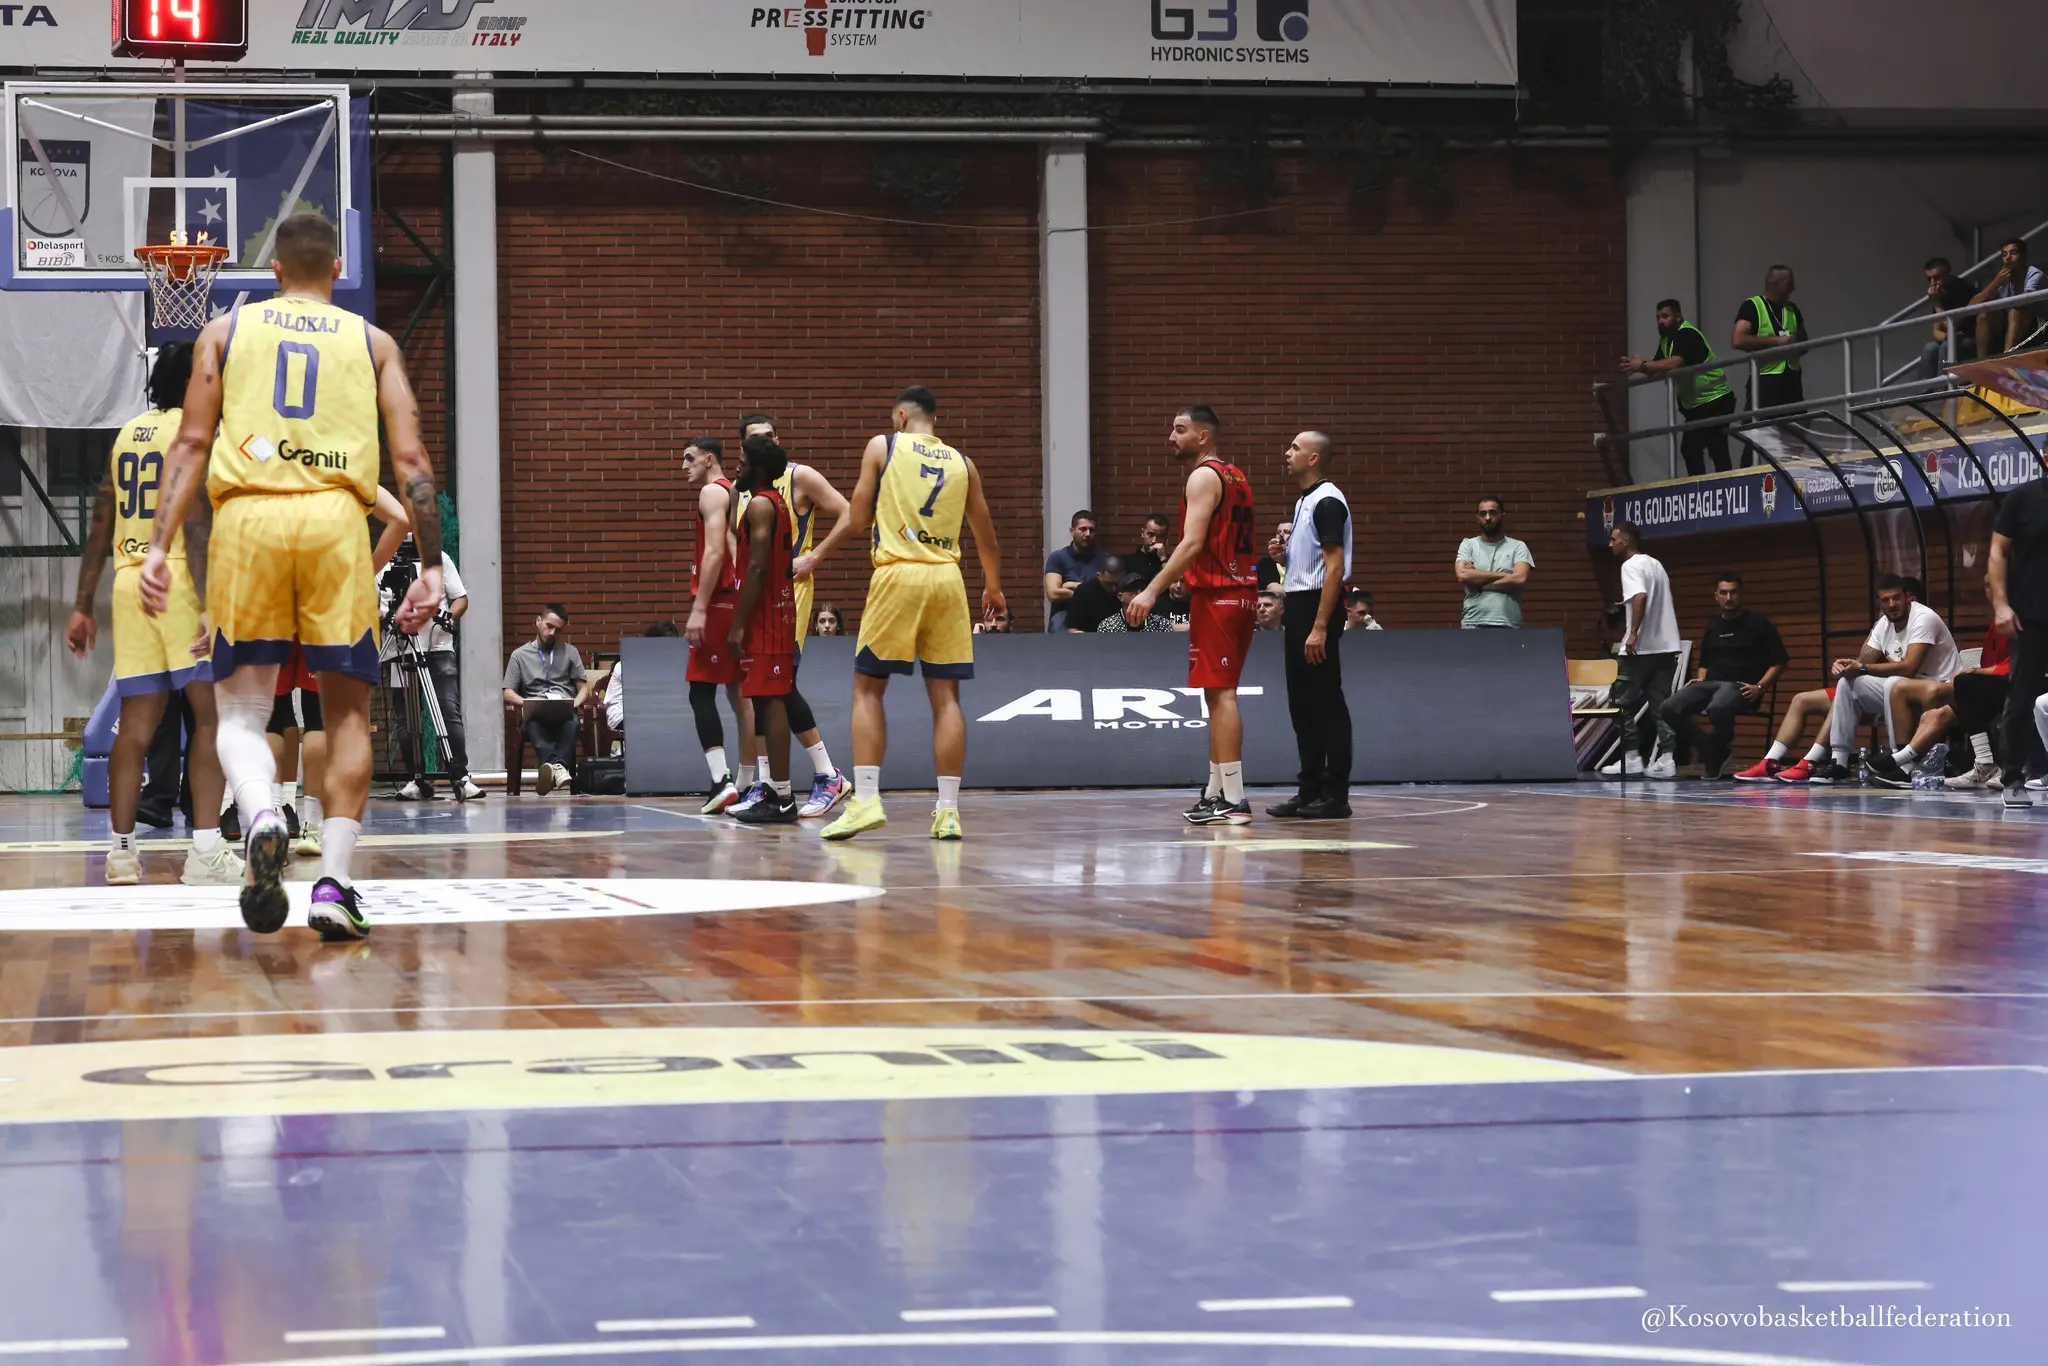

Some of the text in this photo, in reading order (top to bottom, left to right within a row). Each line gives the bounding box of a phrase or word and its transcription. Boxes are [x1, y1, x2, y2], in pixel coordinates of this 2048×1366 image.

[150, 0, 201, 39] 14
[476, 16, 527, 31] GROUP
[291, 31, 328, 44] REAL
[333, 31, 400, 45] QUALITY
[471, 33, 521, 46] ITALY
[830, 34, 878, 46] SYSTEM
[1151, 46, 1310, 63] HYDRONIC SYSTEMS
[30, 167, 78, 178] KOOVA
[37, 241, 84, 251] Delasport
[36, 256, 73, 266] BIBL
[263, 309, 341, 334] PALOKAJ
[272, 340, 320, 420] 0
[278, 439, 348, 470] Graniti
[117, 451, 164, 519] 92
[919, 463, 944, 517] 7
[1625, 485, 1749, 526] K.B. GOLDEN EAGLE YLLI
[976, 686, 1264, 722] ART
[1093, 719, 1208, 730] MOTIO
[80, 1038, 1229, 1086] Graniti
